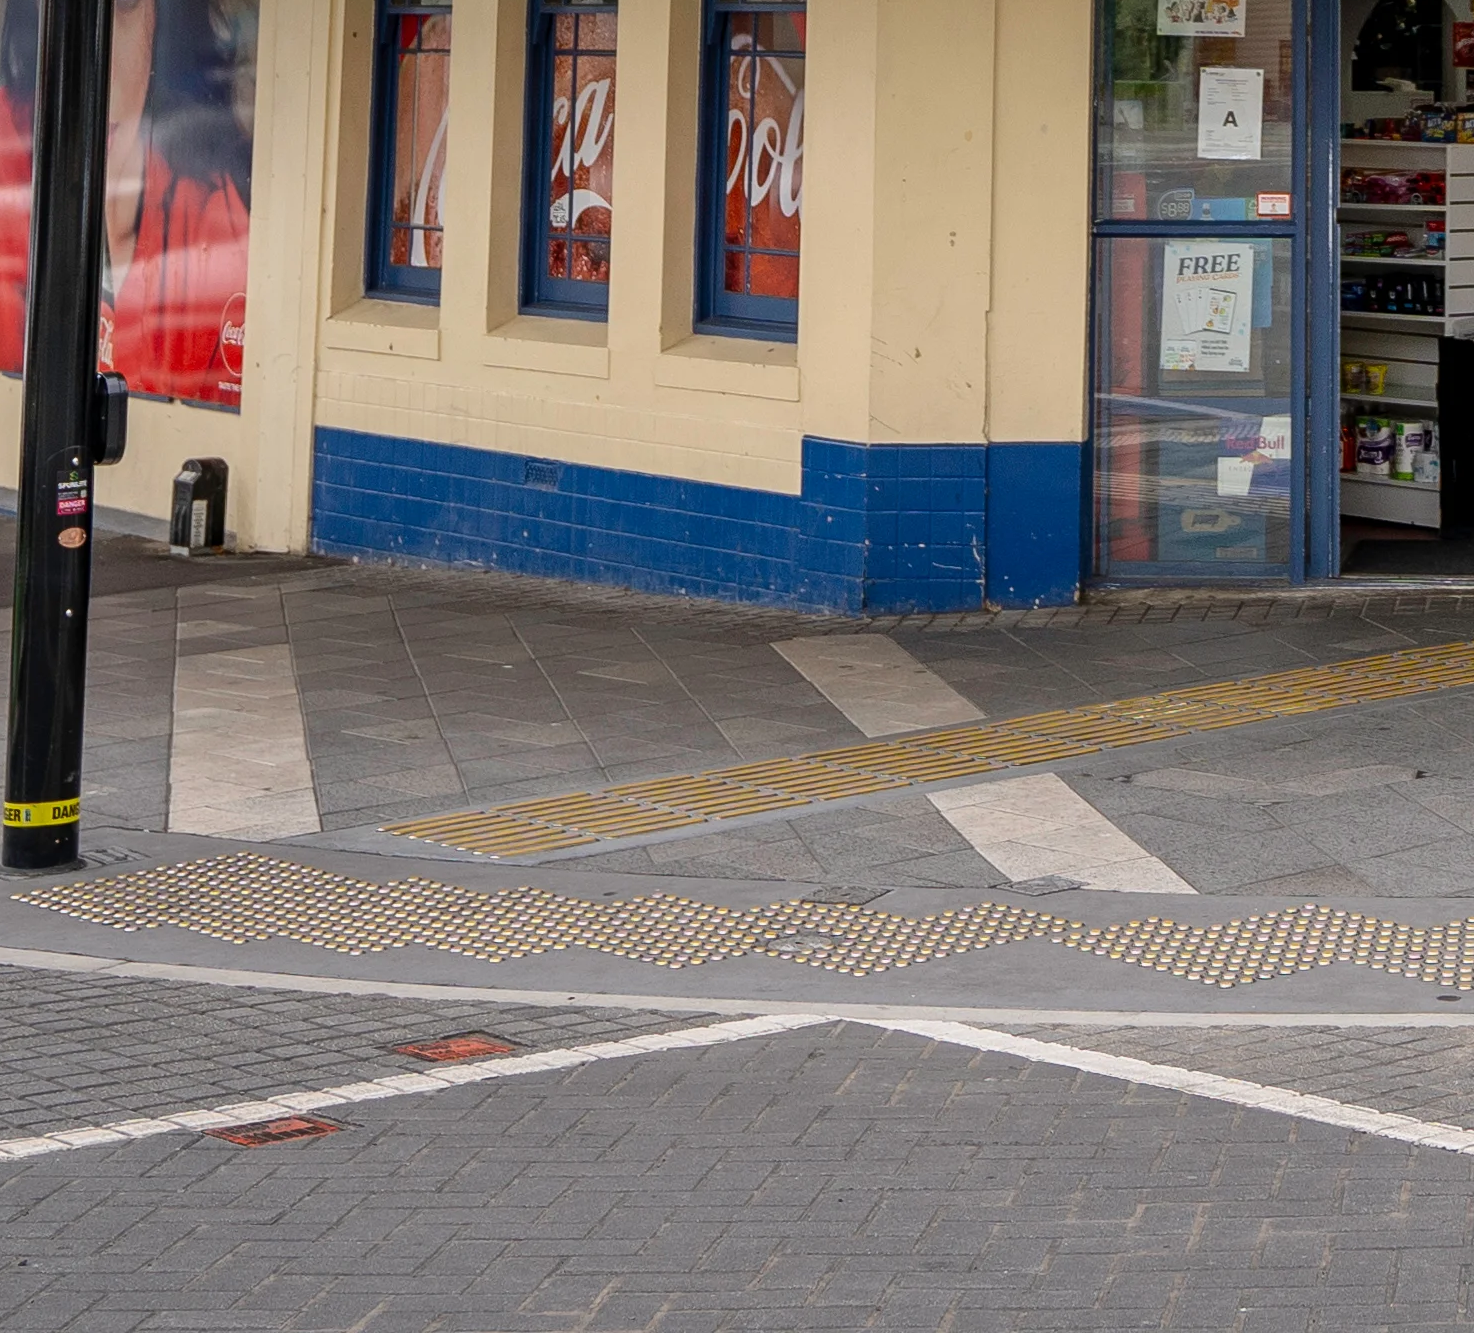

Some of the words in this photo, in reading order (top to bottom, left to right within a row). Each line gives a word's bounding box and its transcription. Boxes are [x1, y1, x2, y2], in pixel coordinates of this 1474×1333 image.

[1222, 110, 1239, 127] A
[1177, 253, 1241, 276] FREE
[1176, 273, 1210, 284] PLAYING
[1212, 271, 1240, 282] CARDS
[1226, 436, 1257, 450] Red
[1258, 435, 1285, 450] Bull
[58, 499, 85, 509] DANGER
